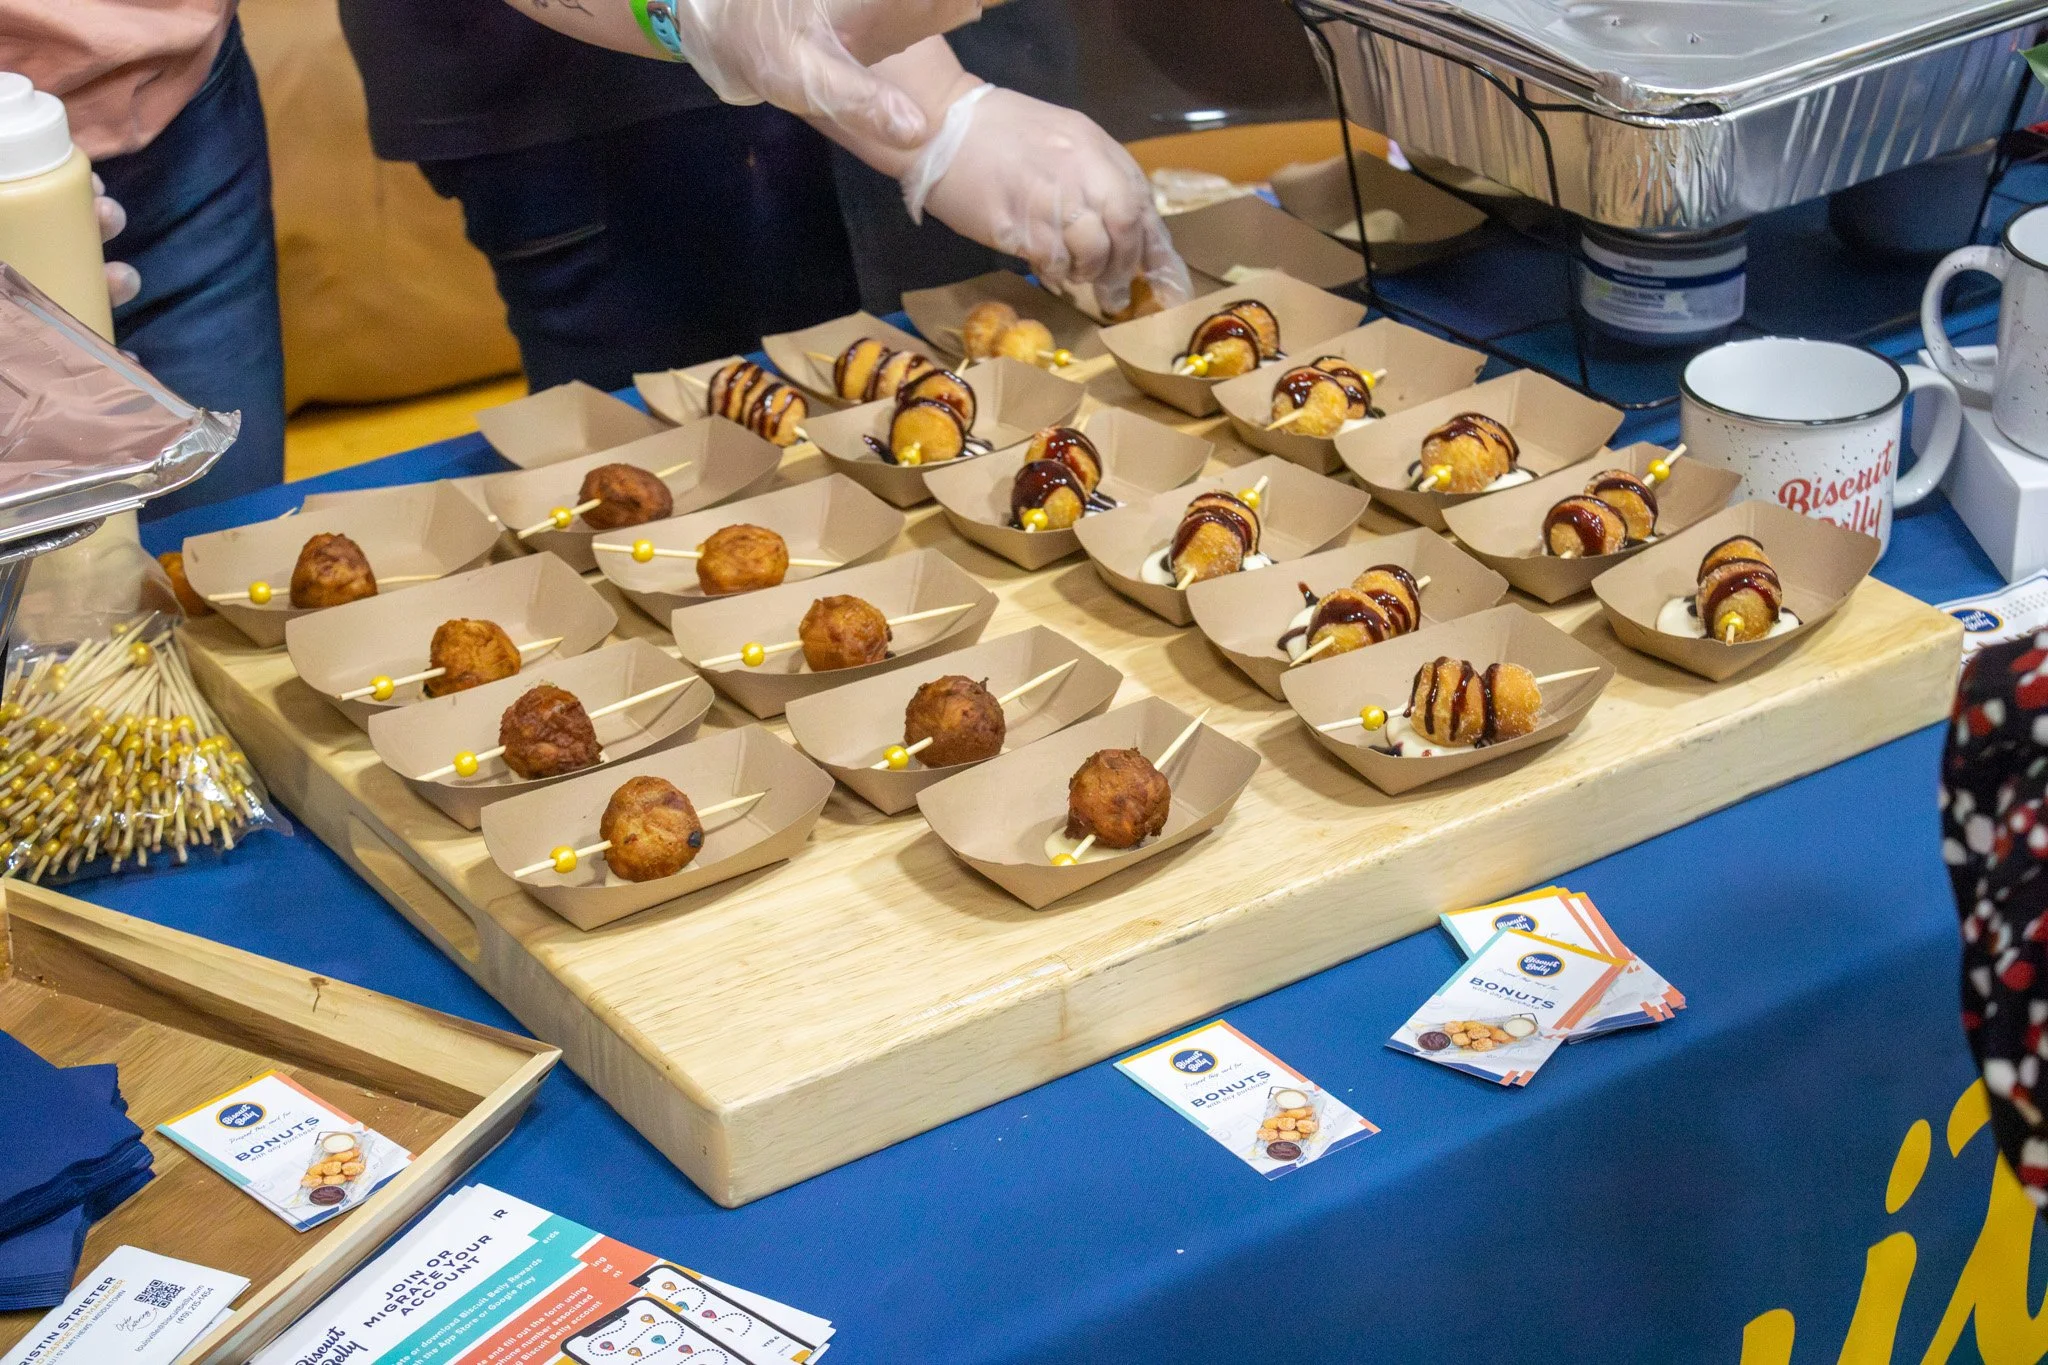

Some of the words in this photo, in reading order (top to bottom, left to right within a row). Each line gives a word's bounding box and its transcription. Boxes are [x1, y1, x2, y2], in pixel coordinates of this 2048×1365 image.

[1778, 440, 1895, 515] Biscuit
[1523, 956, 1560, 968] Biscuit
[1525, 963, 1551, 975] Belly
[1469, 977, 1556, 1009] BONUTS
[1175, 1050, 1203, 1070] Biscuit
[1187, 1058, 1212, 1072] Belly
[1191, 1070, 1271, 1108] BONUTS
[221, 1103, 251, 1126] Biscuit
[234, 1110, 260, 1127] Belly
[235, 1117, 320, 1161] BONUTS
[363, 1270, 445, 1328] MIGRATE
[442, 1234, 494, 1270] YOUR
[384, 1270, 425, 1300] JOIN
[426, 1250, 454, 1269] OR
[400, 1255, 481, 1317] ACCOUNT
[44, 1312, 90, 1359] MARKETING
[87, 1278, 126, 1316] MANAGER
[57, 1276, 116, 1331] STRIETER
[92, 1289, 126, 1322] MIDDLETOWN
[410, 1347, 420, 1355] or
[421, 1317, 461, 1348] download
[459, 1296, 489, 1318] Biscuit
[486, 1282, 510, 1299] Belly
[506, 1257, 543, 1283] Rewards
[422, 1347, 439, 1359] the
[438, 1333, 457, 1348] App
[455, 1317, 479, 1335] Store
[478, 1310, 489, 1319] or
[487, 1288, 518, 1312] Google
[515, 1276, 536, 1290] Play
[487, 1346, 505, 1360] and
[503, 1337, 517, 1348] fill
[516, 1326, 532, 1339] out
[529, 1316, 545, 1329] the
[543, 1302, 565, 1318] form
[564, 1286, 589, 1304] using
[495, 1348, 521, 1365] phone
[521, 1325, 552, 1349] number
[551, 1293, 594, 1327] associated
[520, 1339, 551, 1361] Biscuit
[549, 1323, 572, 1341] Belly
[570, 1299, 603, 1326] account
